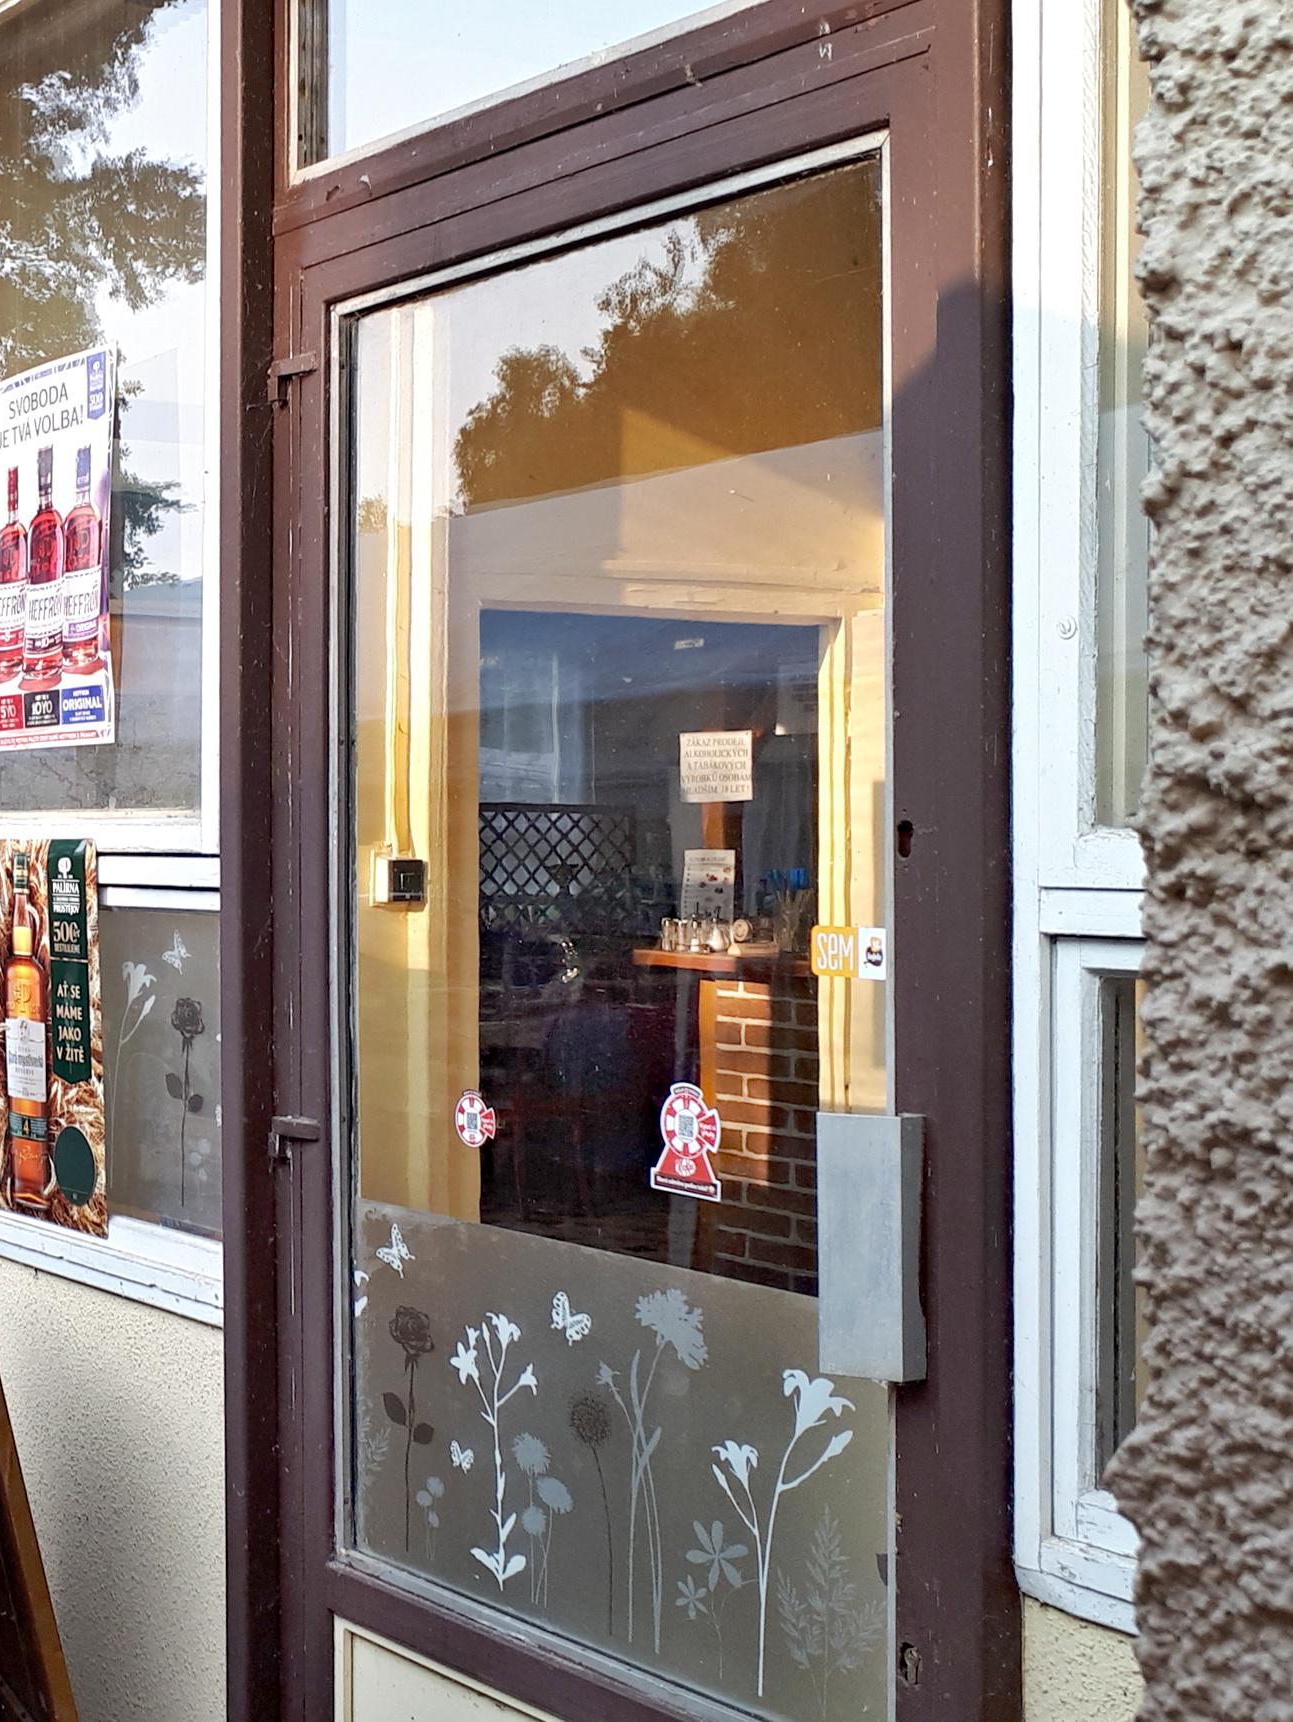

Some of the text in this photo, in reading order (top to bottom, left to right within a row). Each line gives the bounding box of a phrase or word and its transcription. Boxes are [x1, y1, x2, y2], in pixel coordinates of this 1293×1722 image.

[9, 382, 69, 420] SVOBODA
[34, 404, 84, 437] VOLBA!
[0, 704, 17, 719] 5YO
[31, 700, 53, 716] 10YO
[62, 696, 103, 711] ORIGINAL
[52, 881, 80, 894] PALÍRNA
[57, 980, 81, 999] AŤ SE
[56, 1002, 83, 1021] MÁME
[58, 1025, 82, 1041] JAKO
[56, 1044, 85, 1063] V ŽITĚ
